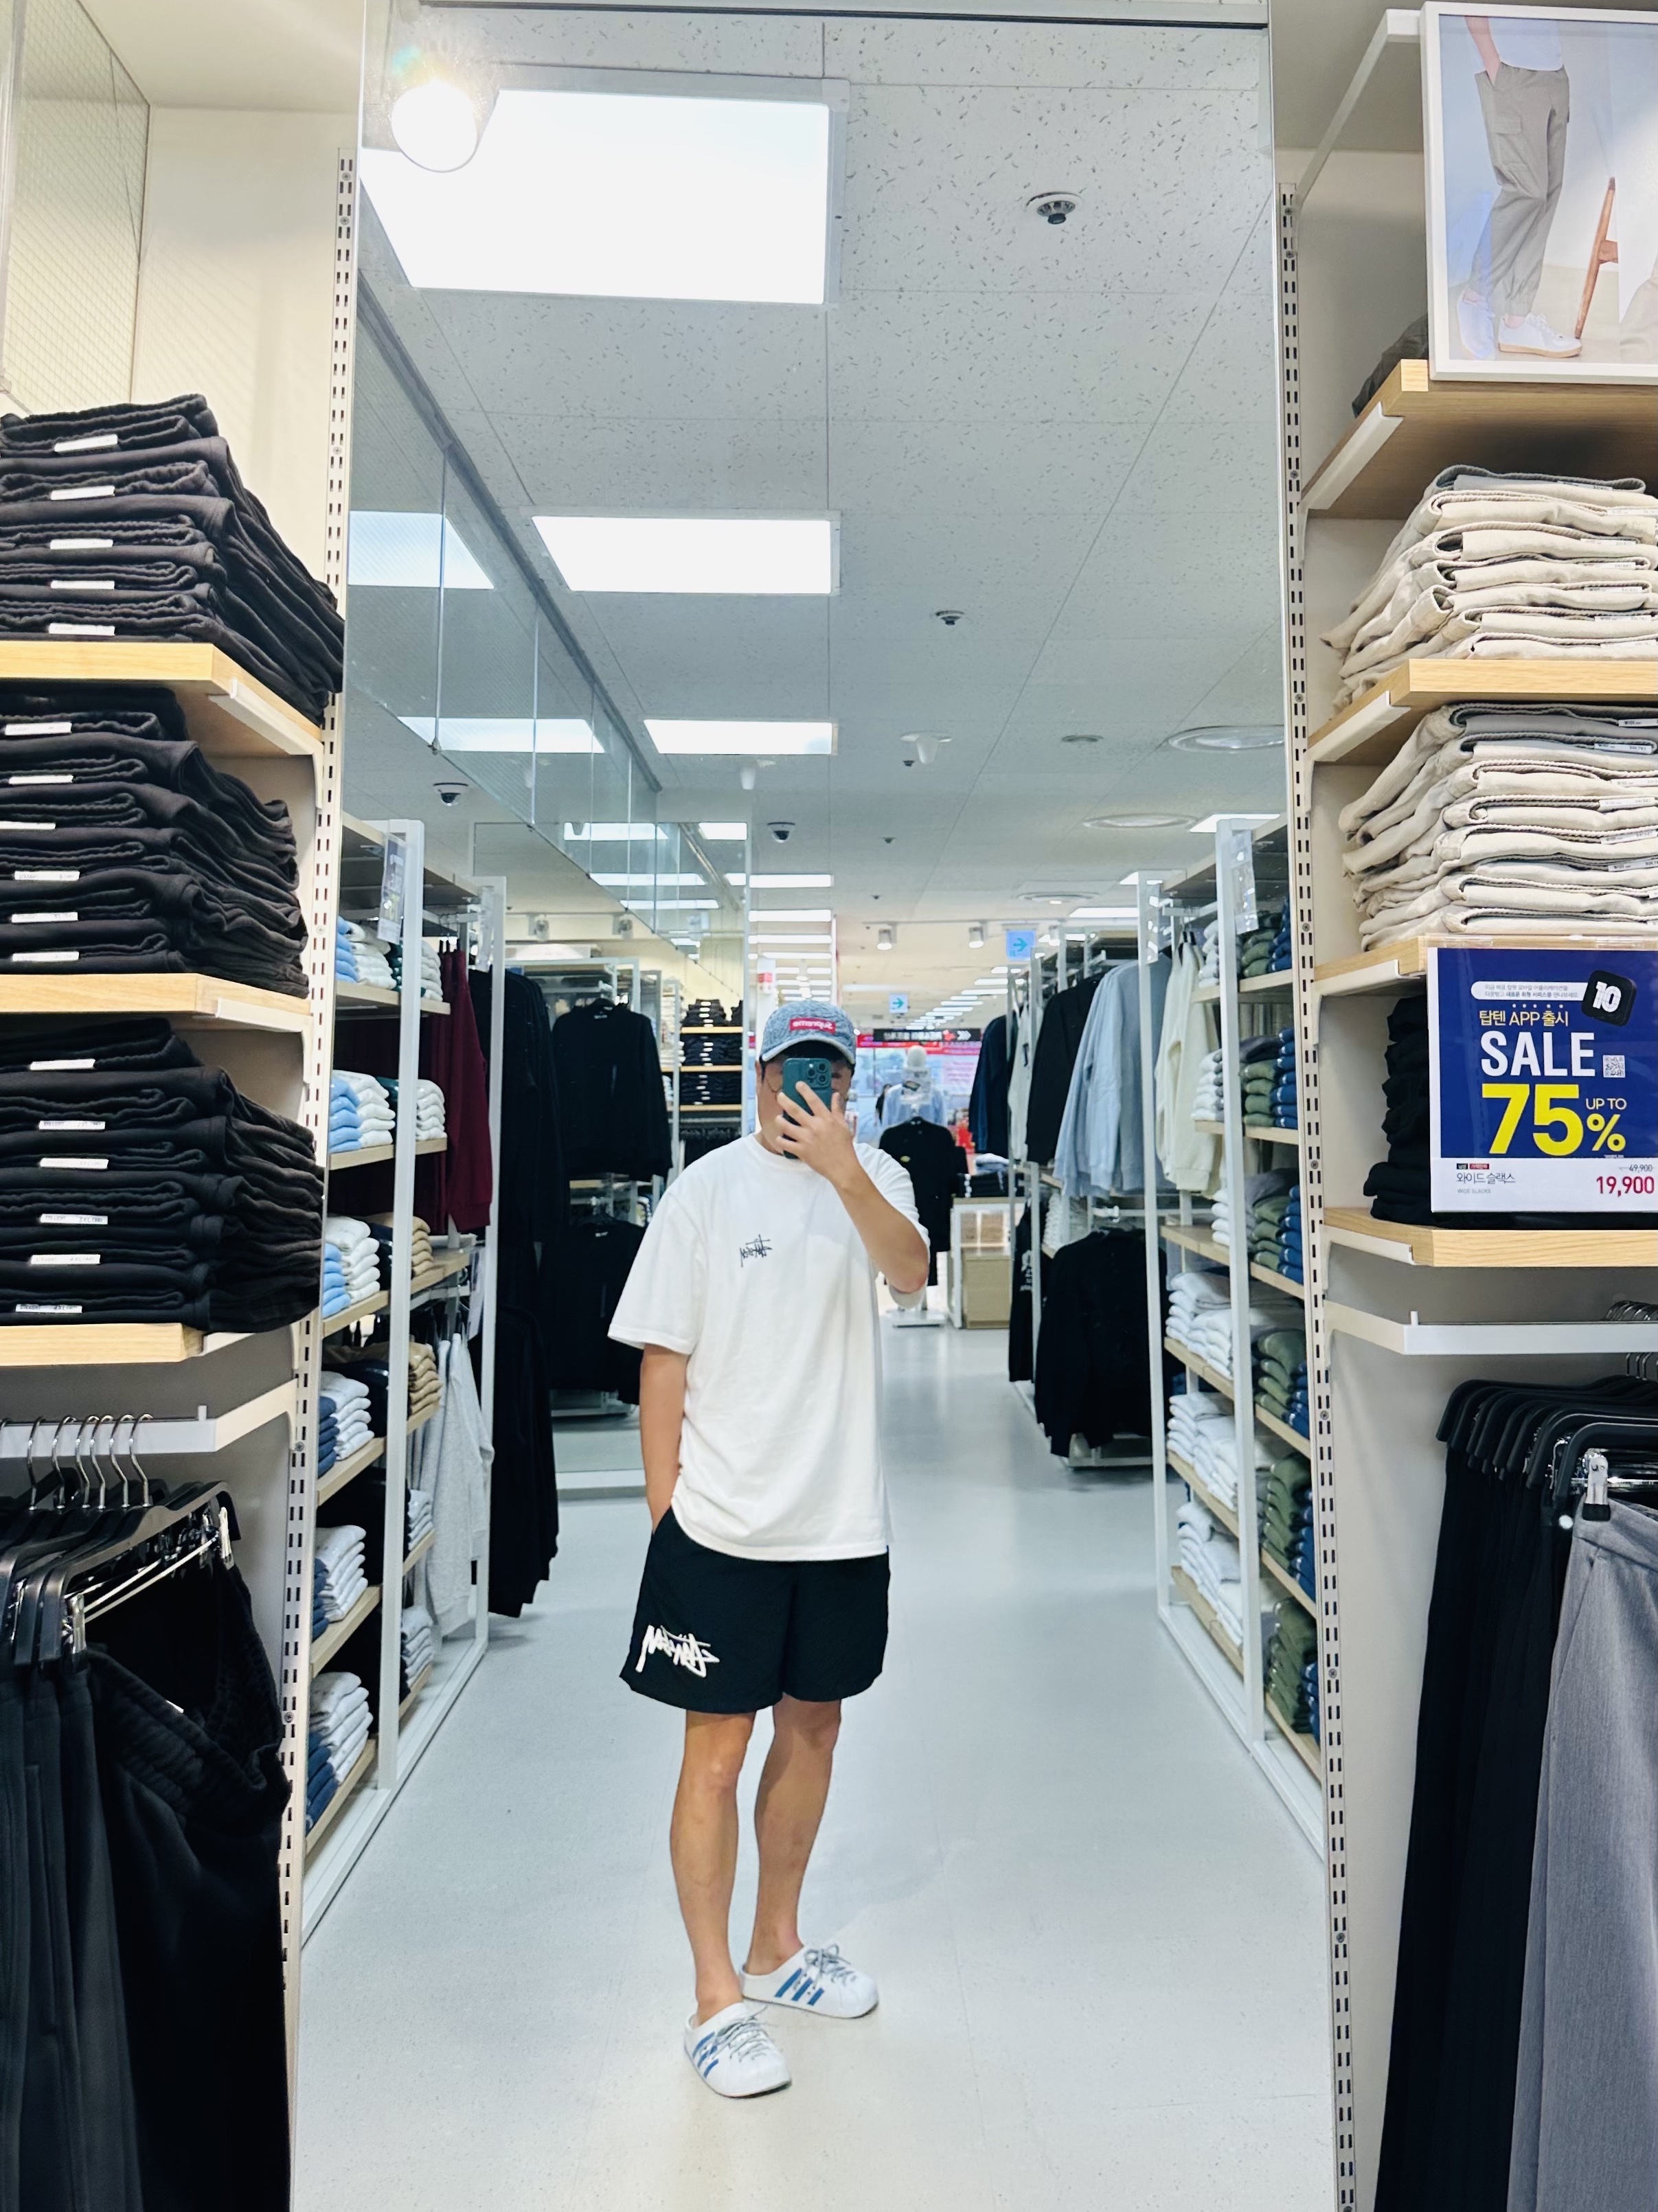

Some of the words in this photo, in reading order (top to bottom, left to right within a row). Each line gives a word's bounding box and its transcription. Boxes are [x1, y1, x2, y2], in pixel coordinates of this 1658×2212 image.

[1592, 981, 1622, 1013] 10
[1479, 1010, 1506, 1026] 탑텐
[1509, 1011, 1540, 1026] APP
[1541, 1010, 1569, 1027] 출시
[1481, 1030, 1595, 1077] SALE
[1585, 1097, 1606, 1110] UP
[1609, 1097, 1627, 1110] TO
[1596, 1175, 1655, 1198] 19,900
